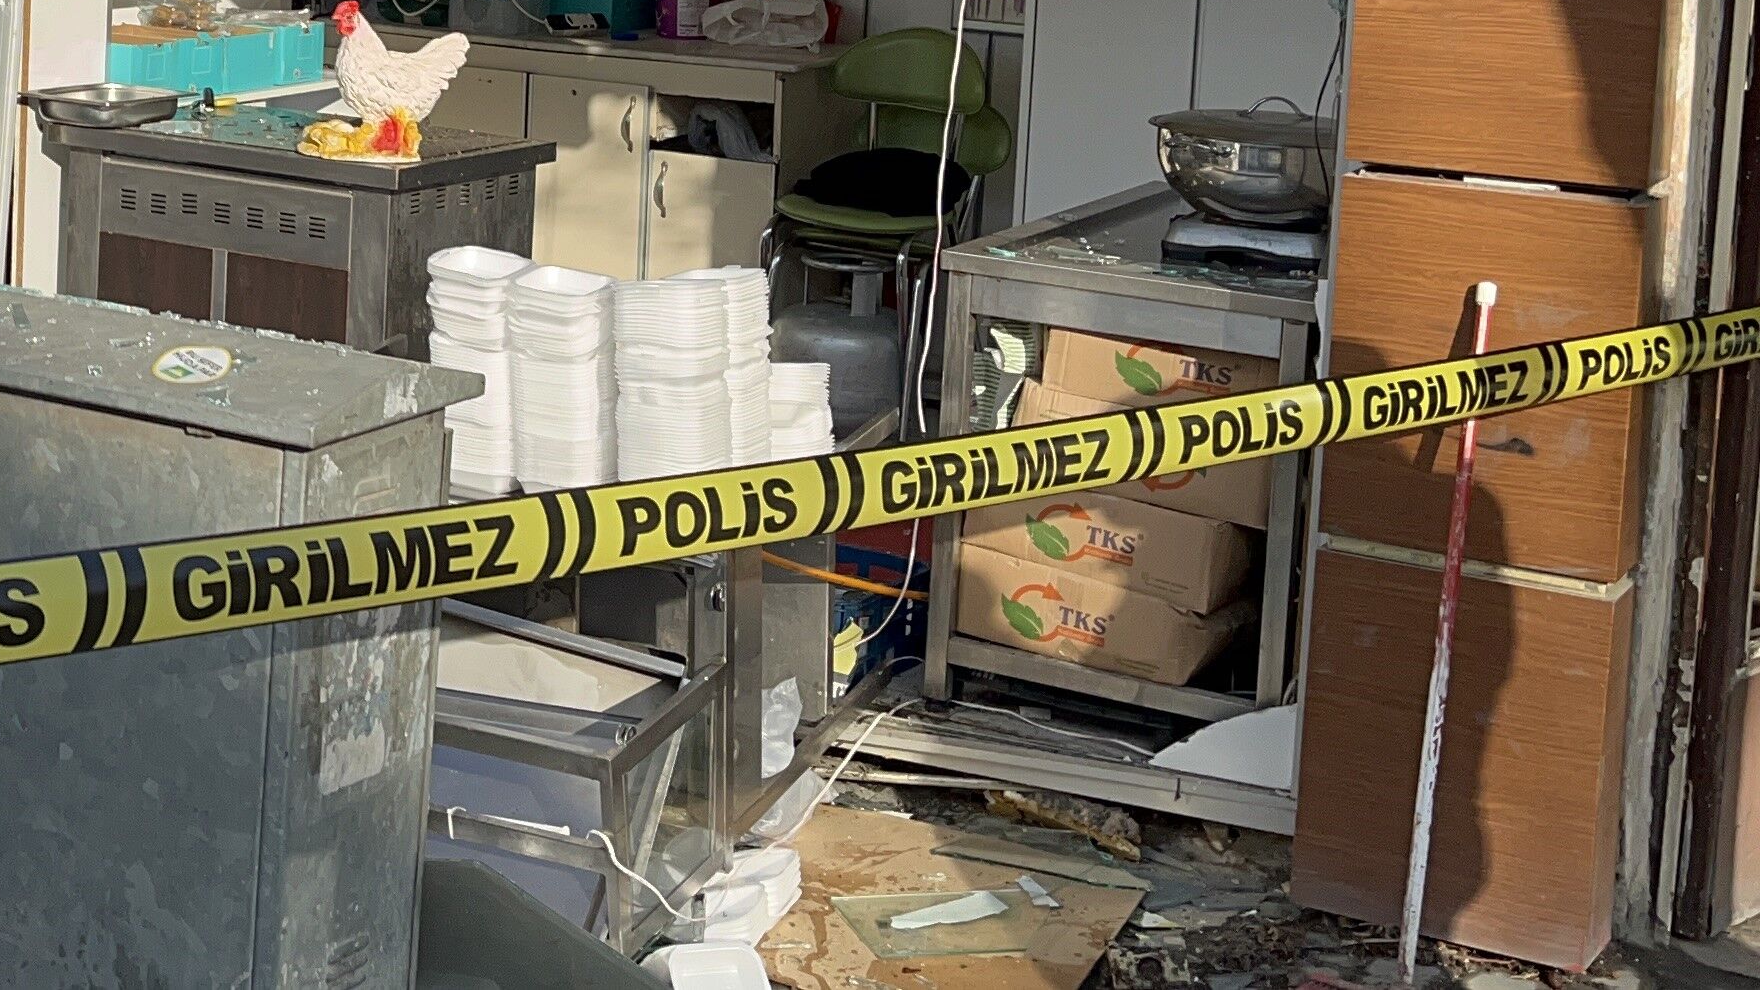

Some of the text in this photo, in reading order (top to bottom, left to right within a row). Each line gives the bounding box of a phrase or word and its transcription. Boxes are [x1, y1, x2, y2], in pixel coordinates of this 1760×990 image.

[172, 515, 519, 622] GİRİLMEZ
[880, 428, 1111, 514] GİRİLMEZ
[1363, 360, 1529, 430] GİRİLMEZ
